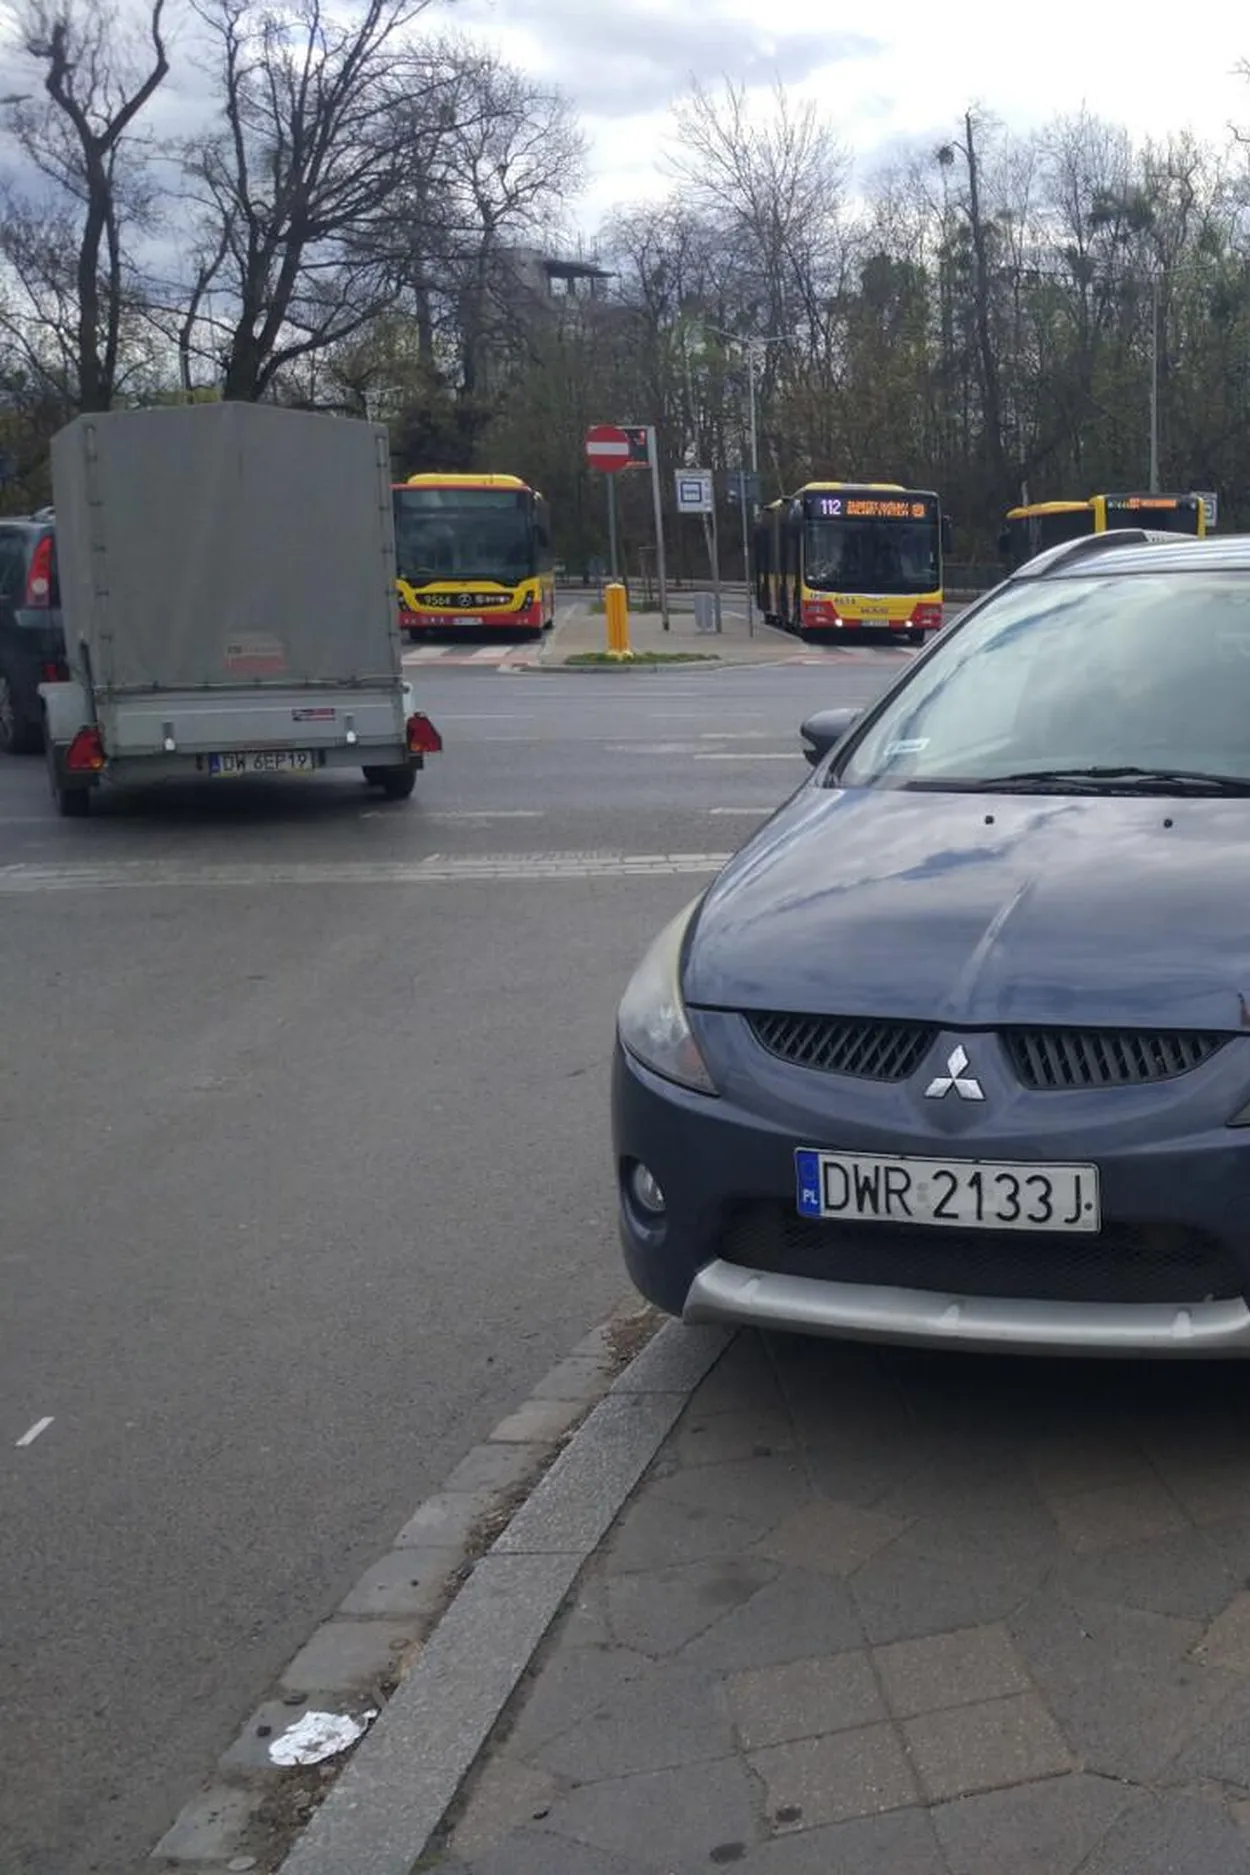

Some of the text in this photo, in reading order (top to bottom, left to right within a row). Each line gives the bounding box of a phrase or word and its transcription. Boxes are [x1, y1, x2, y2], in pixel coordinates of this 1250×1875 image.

[820, 499, 841, 515] 112
[223, 752, 307, 771] DW 6EP19
[802, 1189, 819, 1205] PL
[822, 1161, 1081, 1224] DWR 2133J
